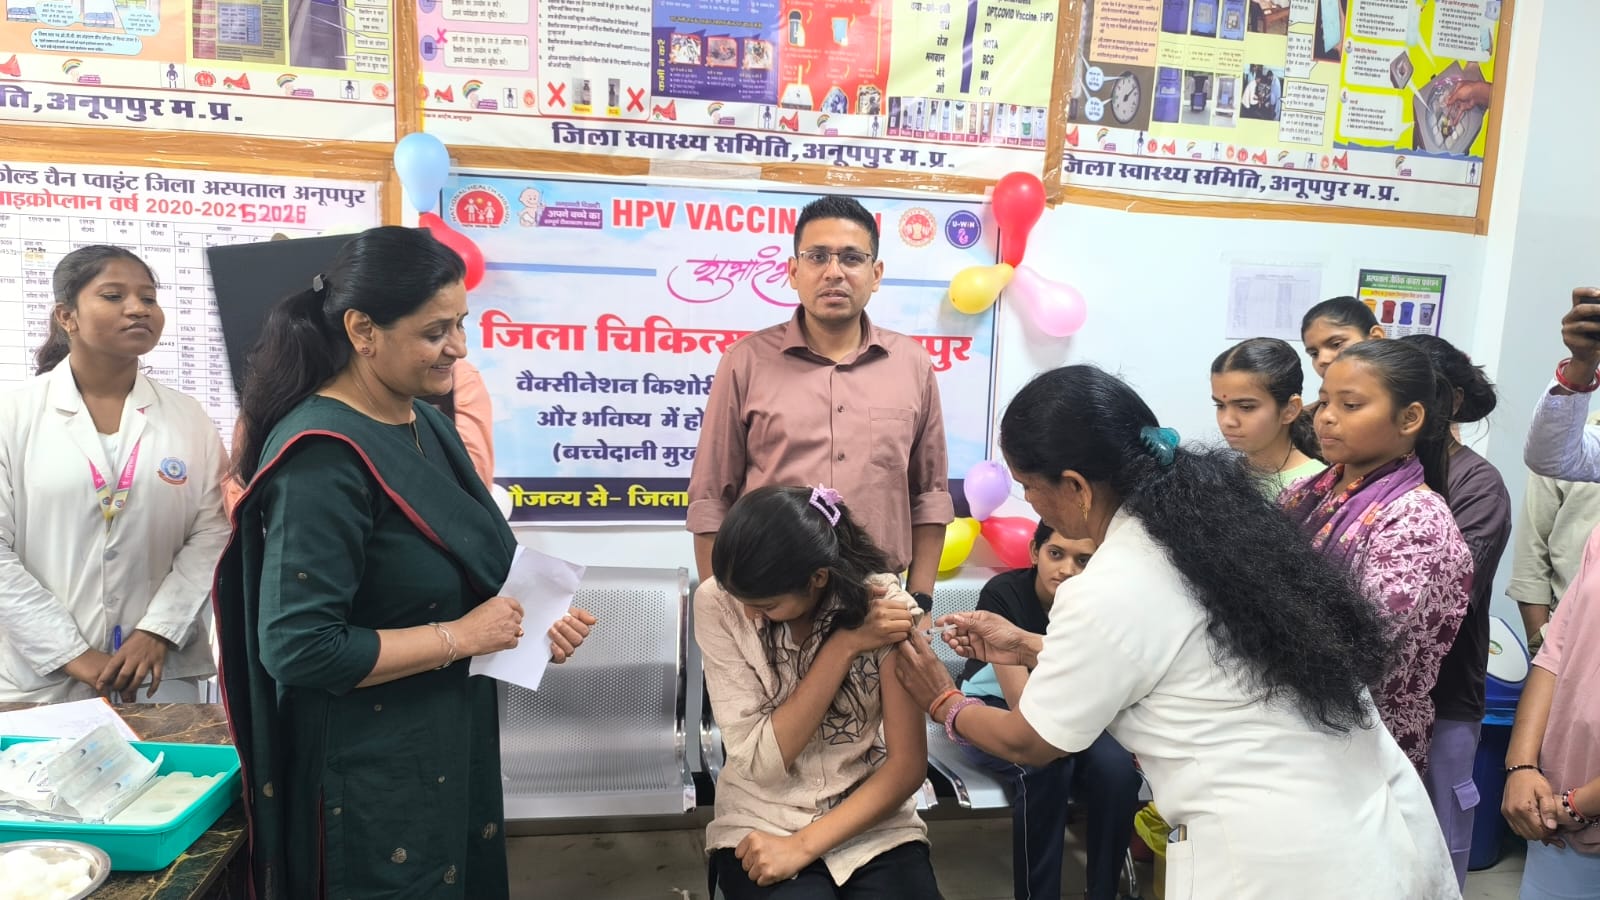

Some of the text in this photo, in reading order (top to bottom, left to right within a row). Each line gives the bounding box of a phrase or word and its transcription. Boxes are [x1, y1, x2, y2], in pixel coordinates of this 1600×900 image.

[552, 121, 621, 147] जिला
[625, 130, 710, 152] स्वास्थ्य
[1118, 162, 1190, 184] स्वास्थ्य
[0, 164, 367, 207] ोल्ड चैन प्वाइंट जिला अस्पताल अनूपपुर
[109, 192, 139, 213] वर्ष
[548, 208, 600, 220] अपने बच्चे का
[613, 199, 676, 229] HPV
[479, 310, 973, 372] जिला चिकित्स पुर
[516, 370, 637, 394] वैक्सीनेशन
[536, 404, 576, 427] और
[582, 405, 652, 428] भविष्य
[661, 406, 679, 428] में
[552, 438, 657, 463] (बच्चेदानी
[508, 484, 582, 507] ौजन्य
[628, 484, 689, 507] जिला
